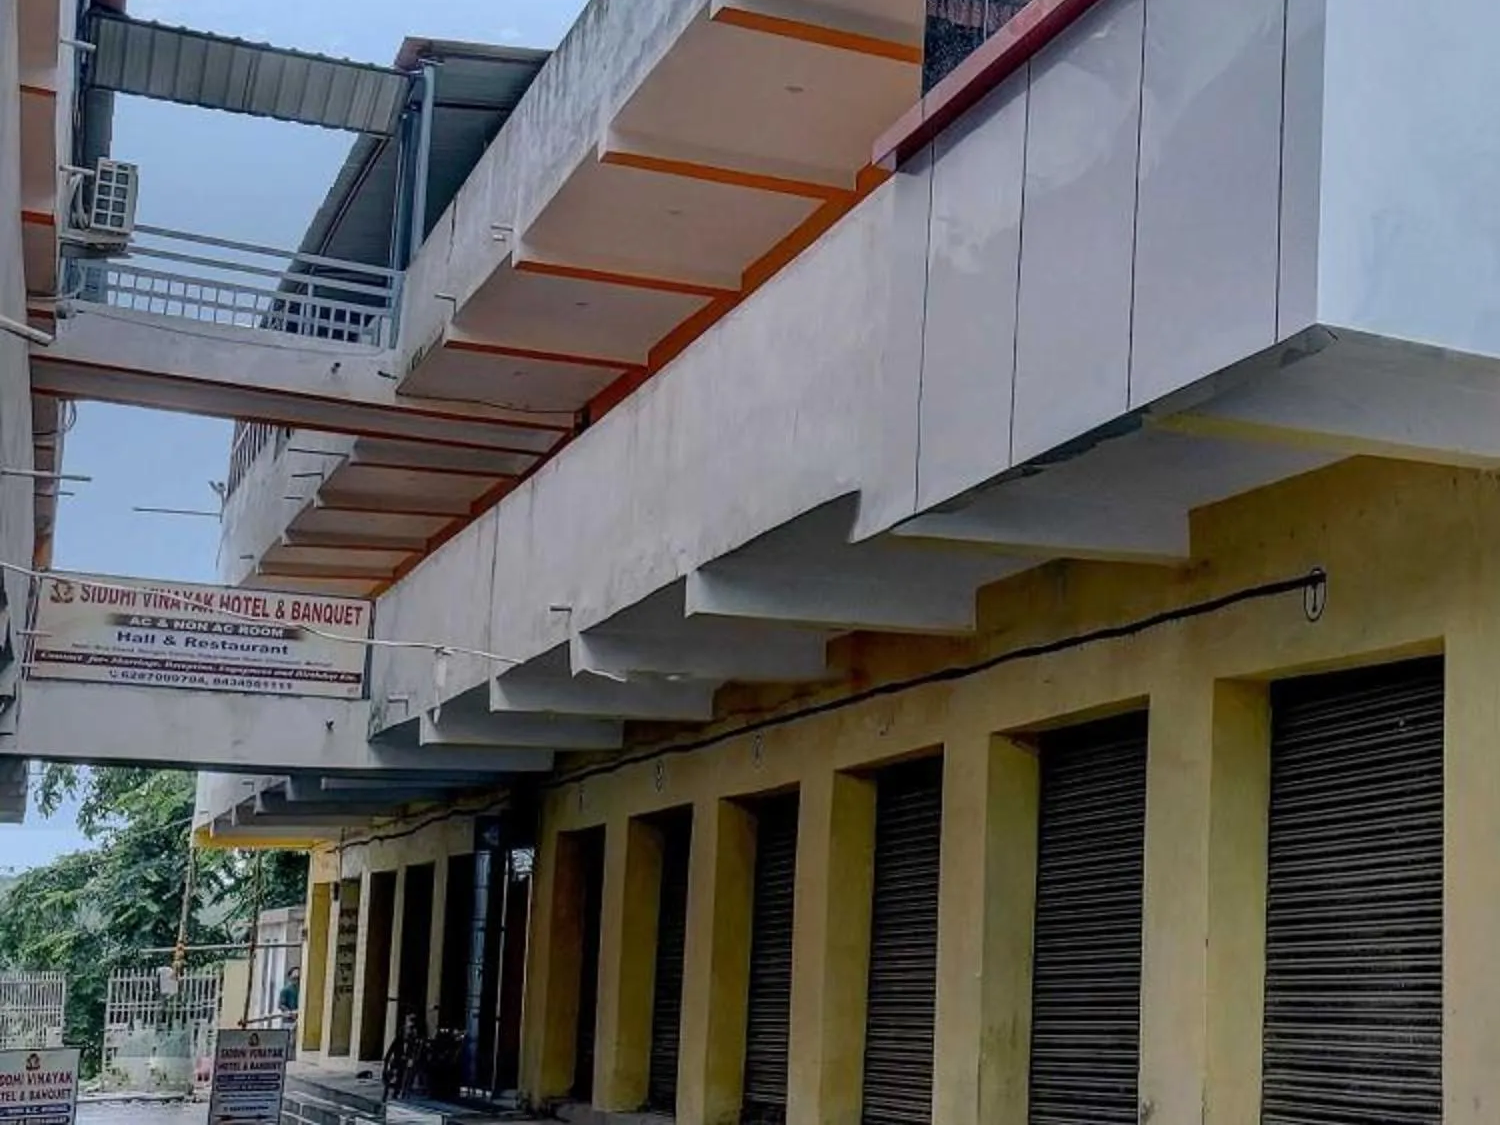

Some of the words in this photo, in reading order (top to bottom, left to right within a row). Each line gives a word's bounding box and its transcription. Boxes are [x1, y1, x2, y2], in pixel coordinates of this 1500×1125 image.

[80, 584, 136, 607] SIDDHI
[220, 594, 269, 618] HOTEL
[275, 599, 285, 619] &
[291, 600, 363, 626] BANQUET
[129, 615, 153, 626] AC
[157, 618, 169, 628] &
[174, 620, 209, 632] NON
[213, 623, 233, 634] AC
[238, 625, 283, 638] ROOM
[116, 631, 156, 645] Hall
[163, 634, 176, 646] &
[184, 636, 289, 655] Restaurant
